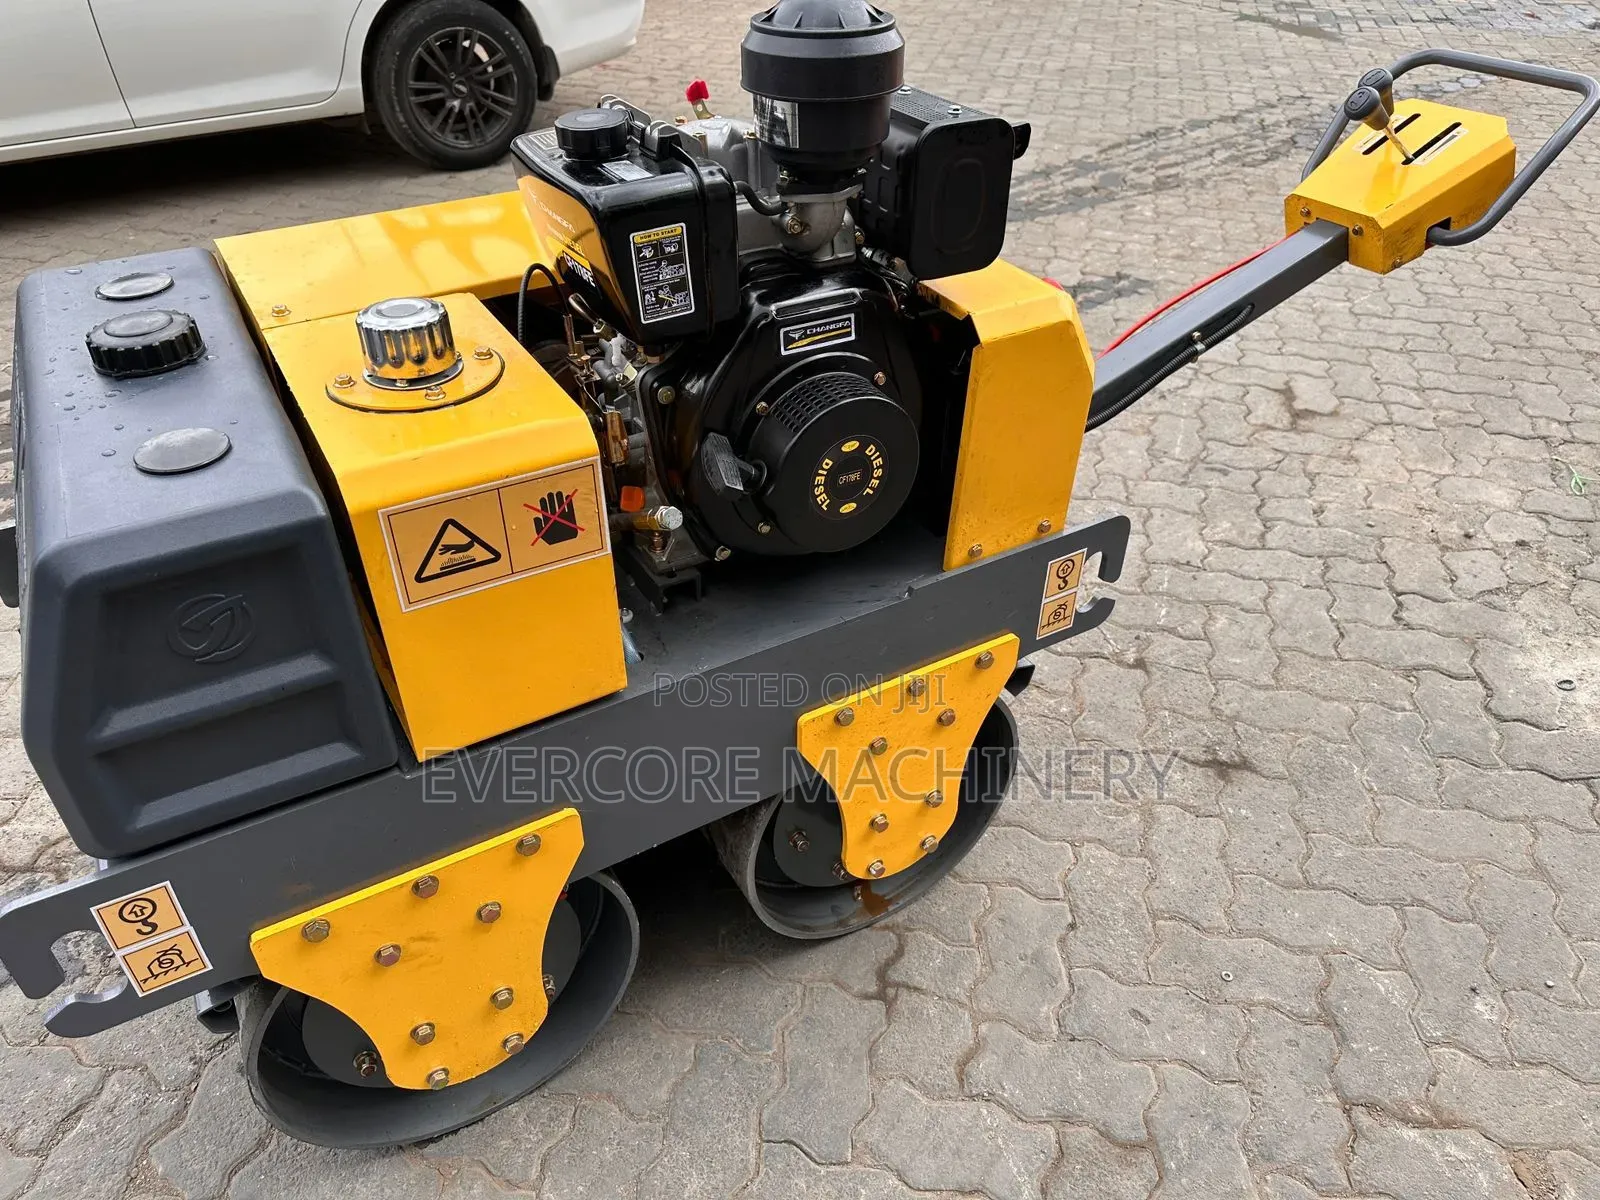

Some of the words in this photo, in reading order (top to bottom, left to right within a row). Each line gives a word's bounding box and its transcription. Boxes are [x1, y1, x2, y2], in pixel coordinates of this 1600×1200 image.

[806, 320, 851, 335] CHANGFA
[814, 458, 833, 511] DIESEL
[864, 444, 883, 496] DIESEL
